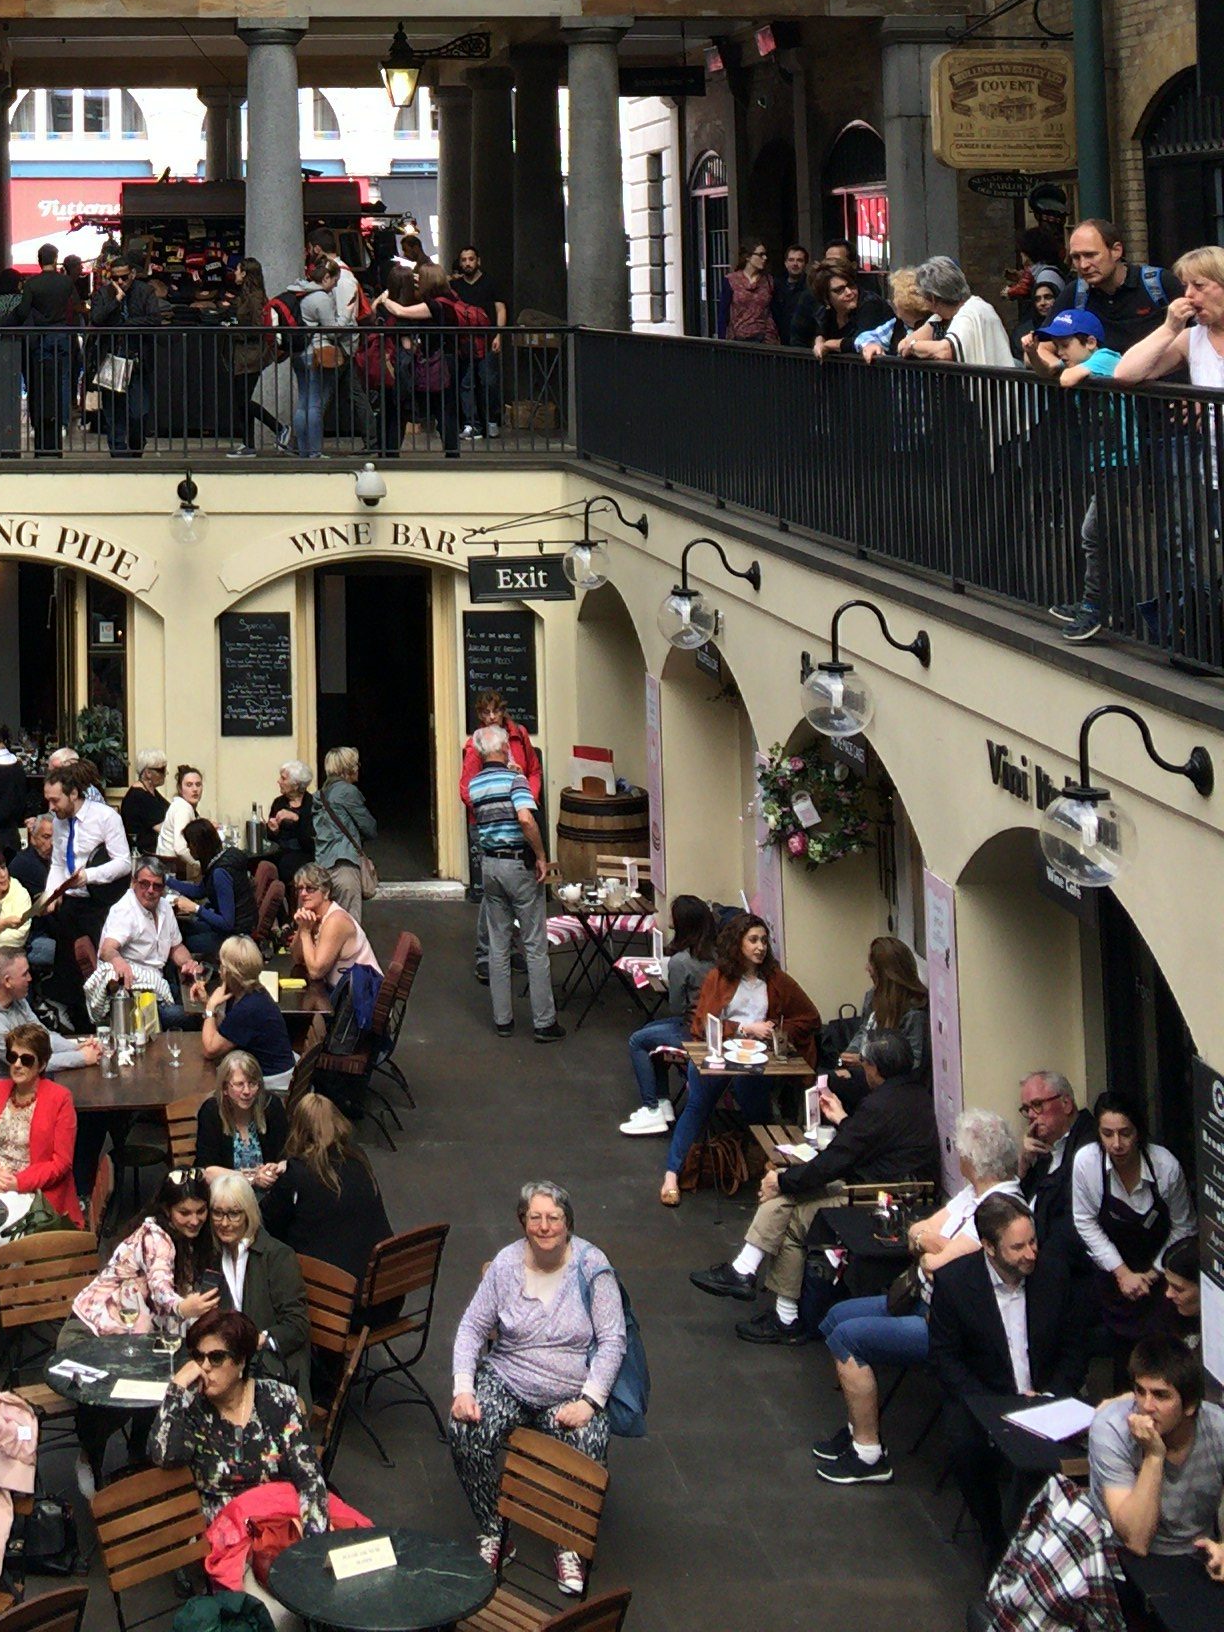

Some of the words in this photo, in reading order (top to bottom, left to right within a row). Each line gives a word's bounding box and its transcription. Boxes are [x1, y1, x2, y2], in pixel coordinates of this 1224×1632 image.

[980, 79, 1036, 93] COVENT
[55, 525, 139, 581] PIPE
[288, 522, 372, 555] WINE
[390, 522, 457, 556] BAR
[496, 566, 548, 589] Exit
[986, 739, 1029, 802] Vini
